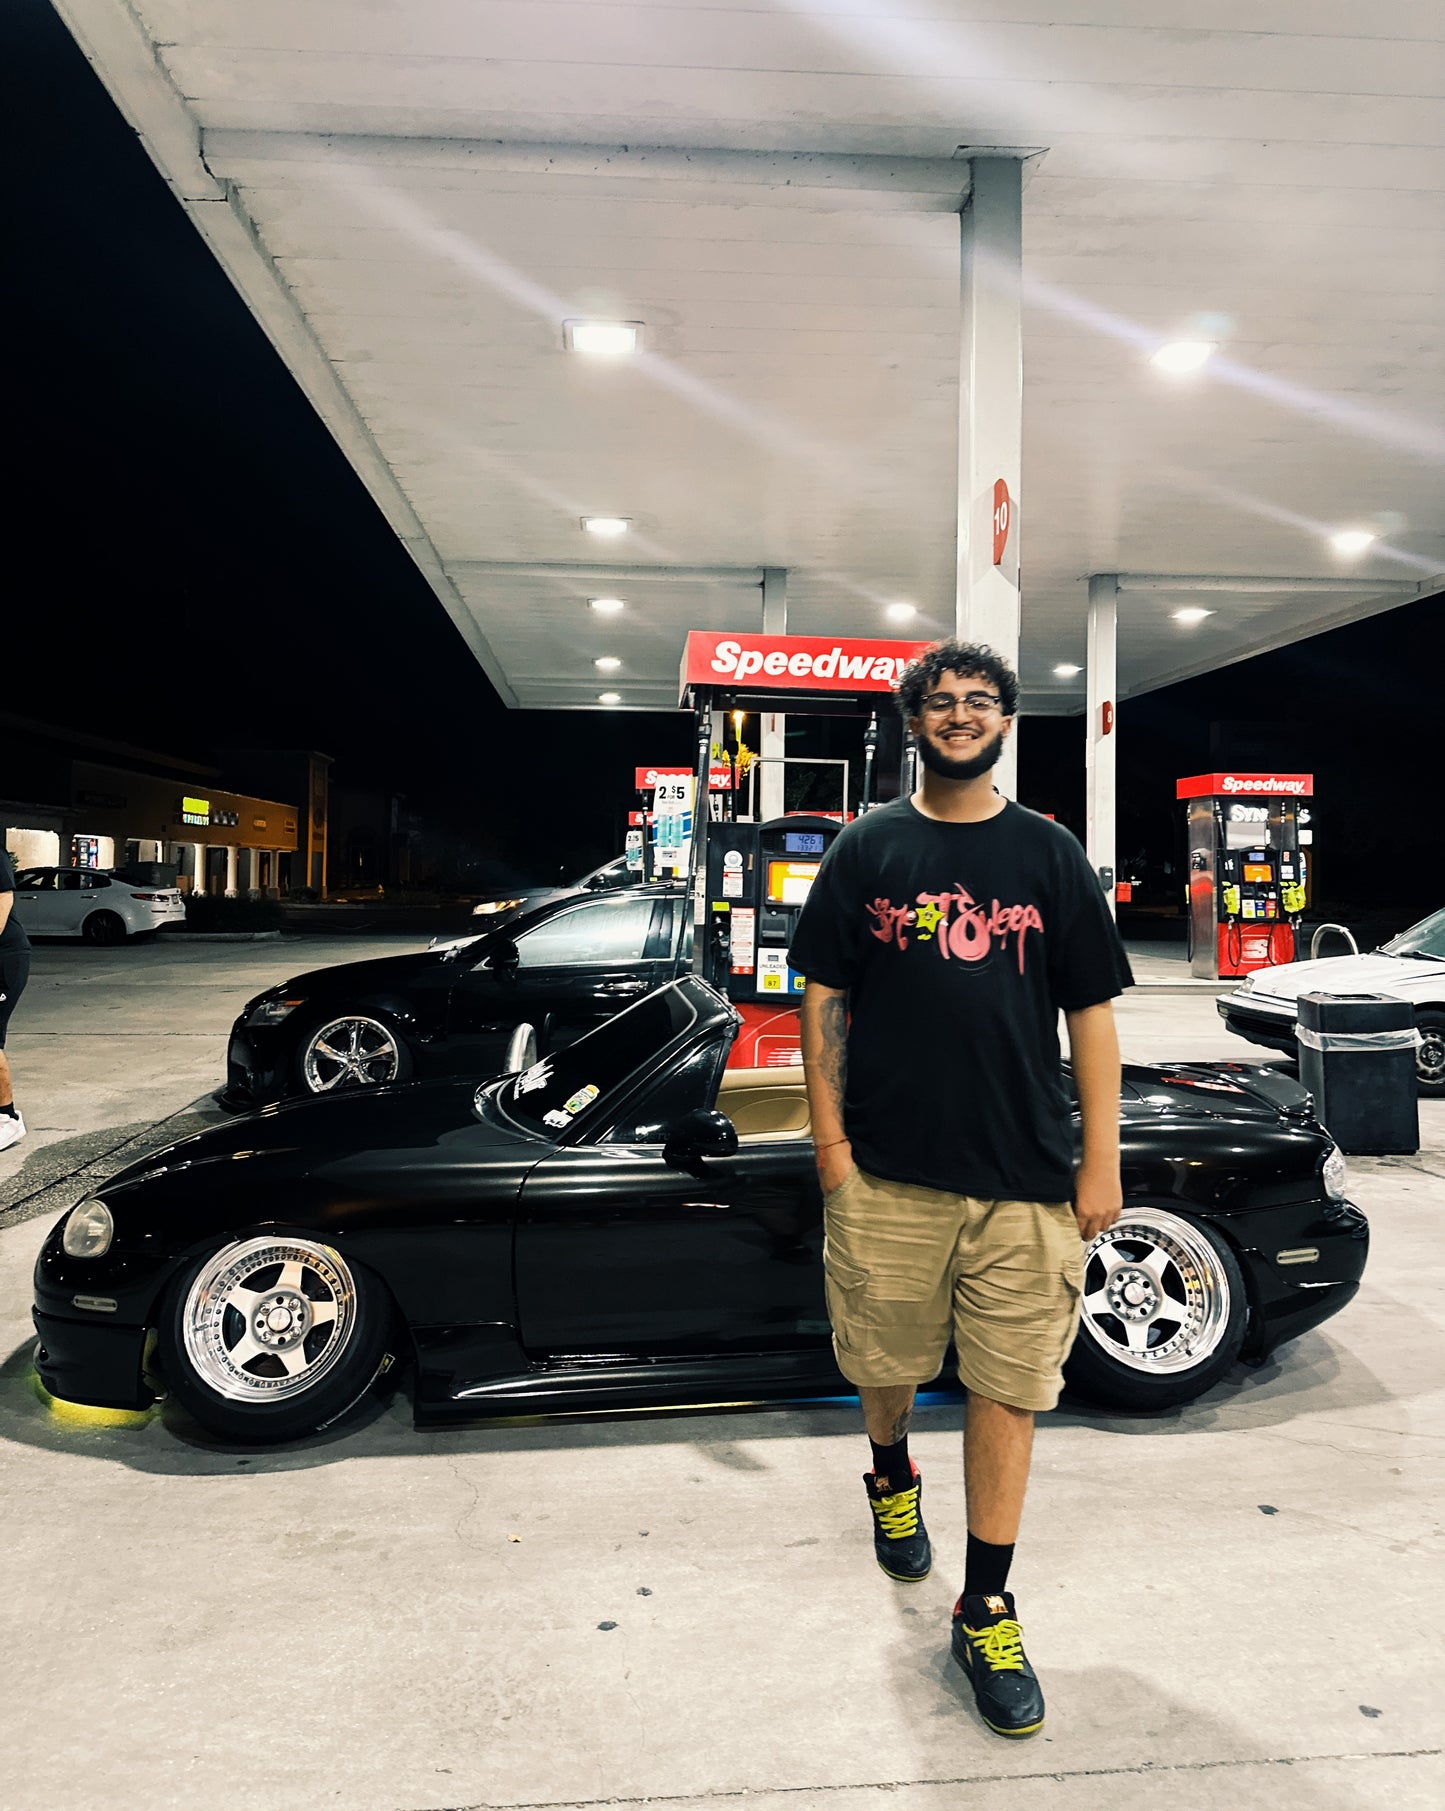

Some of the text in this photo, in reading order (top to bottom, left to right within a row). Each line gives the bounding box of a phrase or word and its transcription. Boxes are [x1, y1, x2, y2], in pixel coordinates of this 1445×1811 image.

[994, 501, 1008, 535] 10
[1106, 710, 1113, 724] 8
[658, 786, 667, 799] 2
